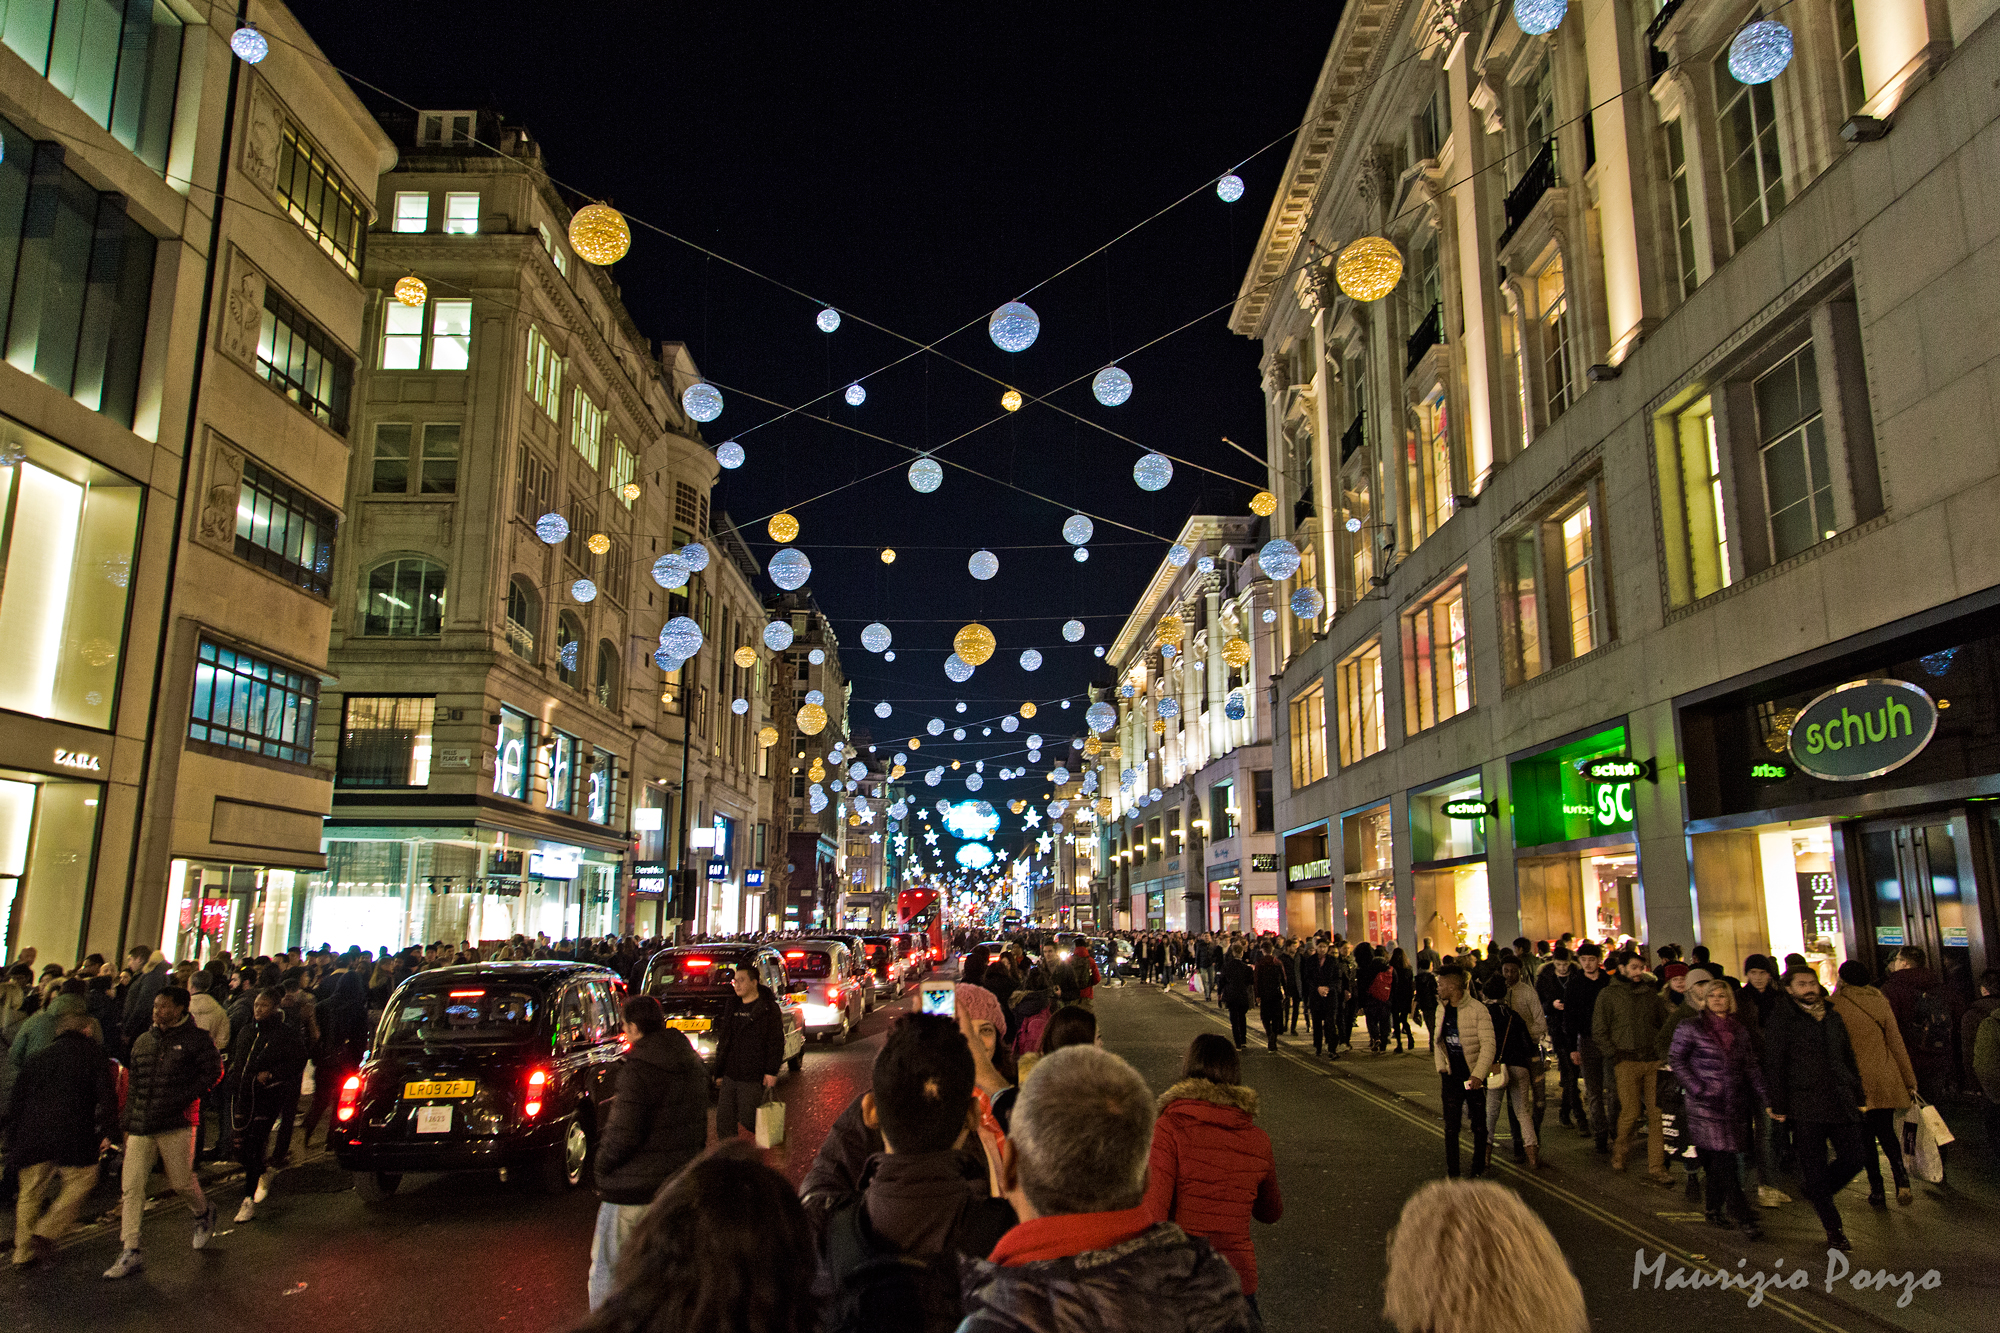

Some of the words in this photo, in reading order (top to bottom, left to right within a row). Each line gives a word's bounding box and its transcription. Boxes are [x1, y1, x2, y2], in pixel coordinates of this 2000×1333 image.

[1806, 696, 1912, 754] schuh
[54, 749, 100, 771] ZARA
[1591, 762, 1640, 776] schuh
[1447, 802, 1487, 814] schuh
[635, 866, 665, 874] Bershka
[709, 865, 722, 875] GAP
[747, 874, 759, 882] GAP
[409, 1083, 441, 1096] LR09
[445, 1083, 469, 1095] ZFJ
